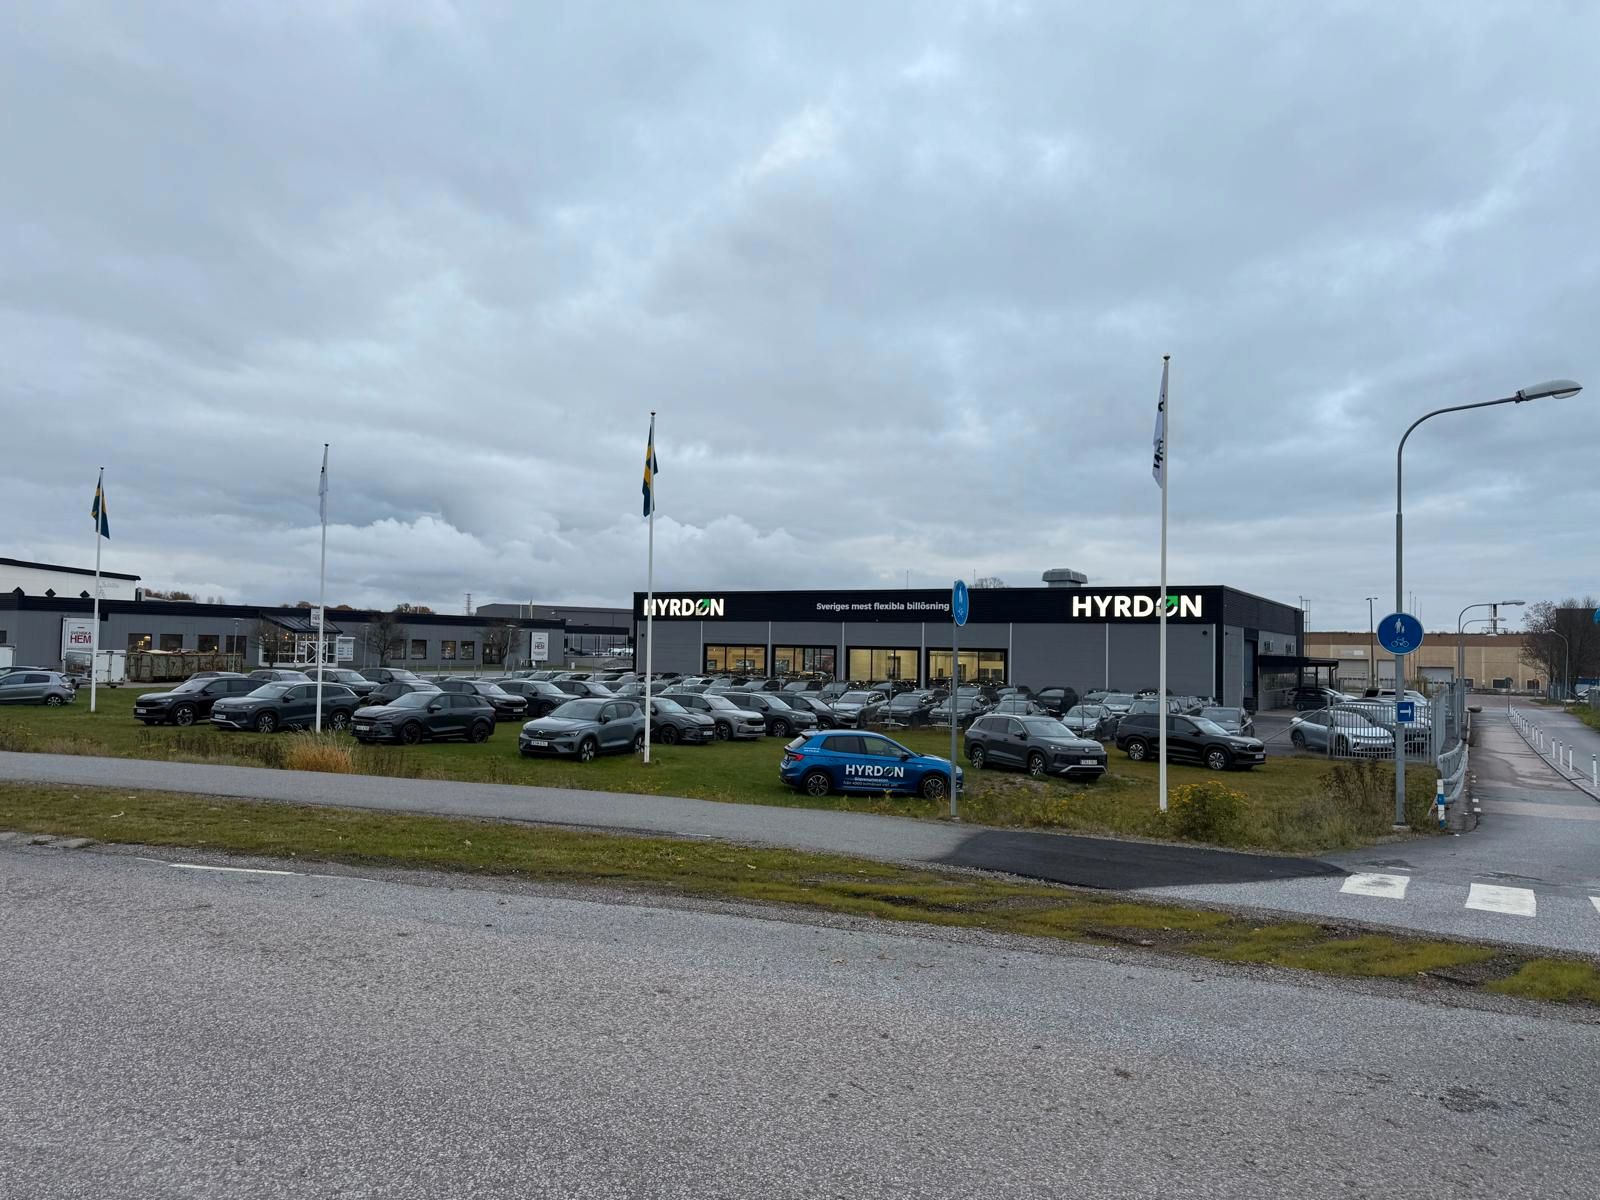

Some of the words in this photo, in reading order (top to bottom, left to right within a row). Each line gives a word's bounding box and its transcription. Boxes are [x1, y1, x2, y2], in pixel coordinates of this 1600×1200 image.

[644, 599, 724, 616] HYRDON
[816, 602, 850, 611] Sveriges
[873, 602, 905, 610] flexibla
[906, 602, 950, 611] billösning
[1072, 595, 1202, 617] HYRDON
[70, 634, 92, 644] HEM
[845, 764, 904, 778] HYRDON
